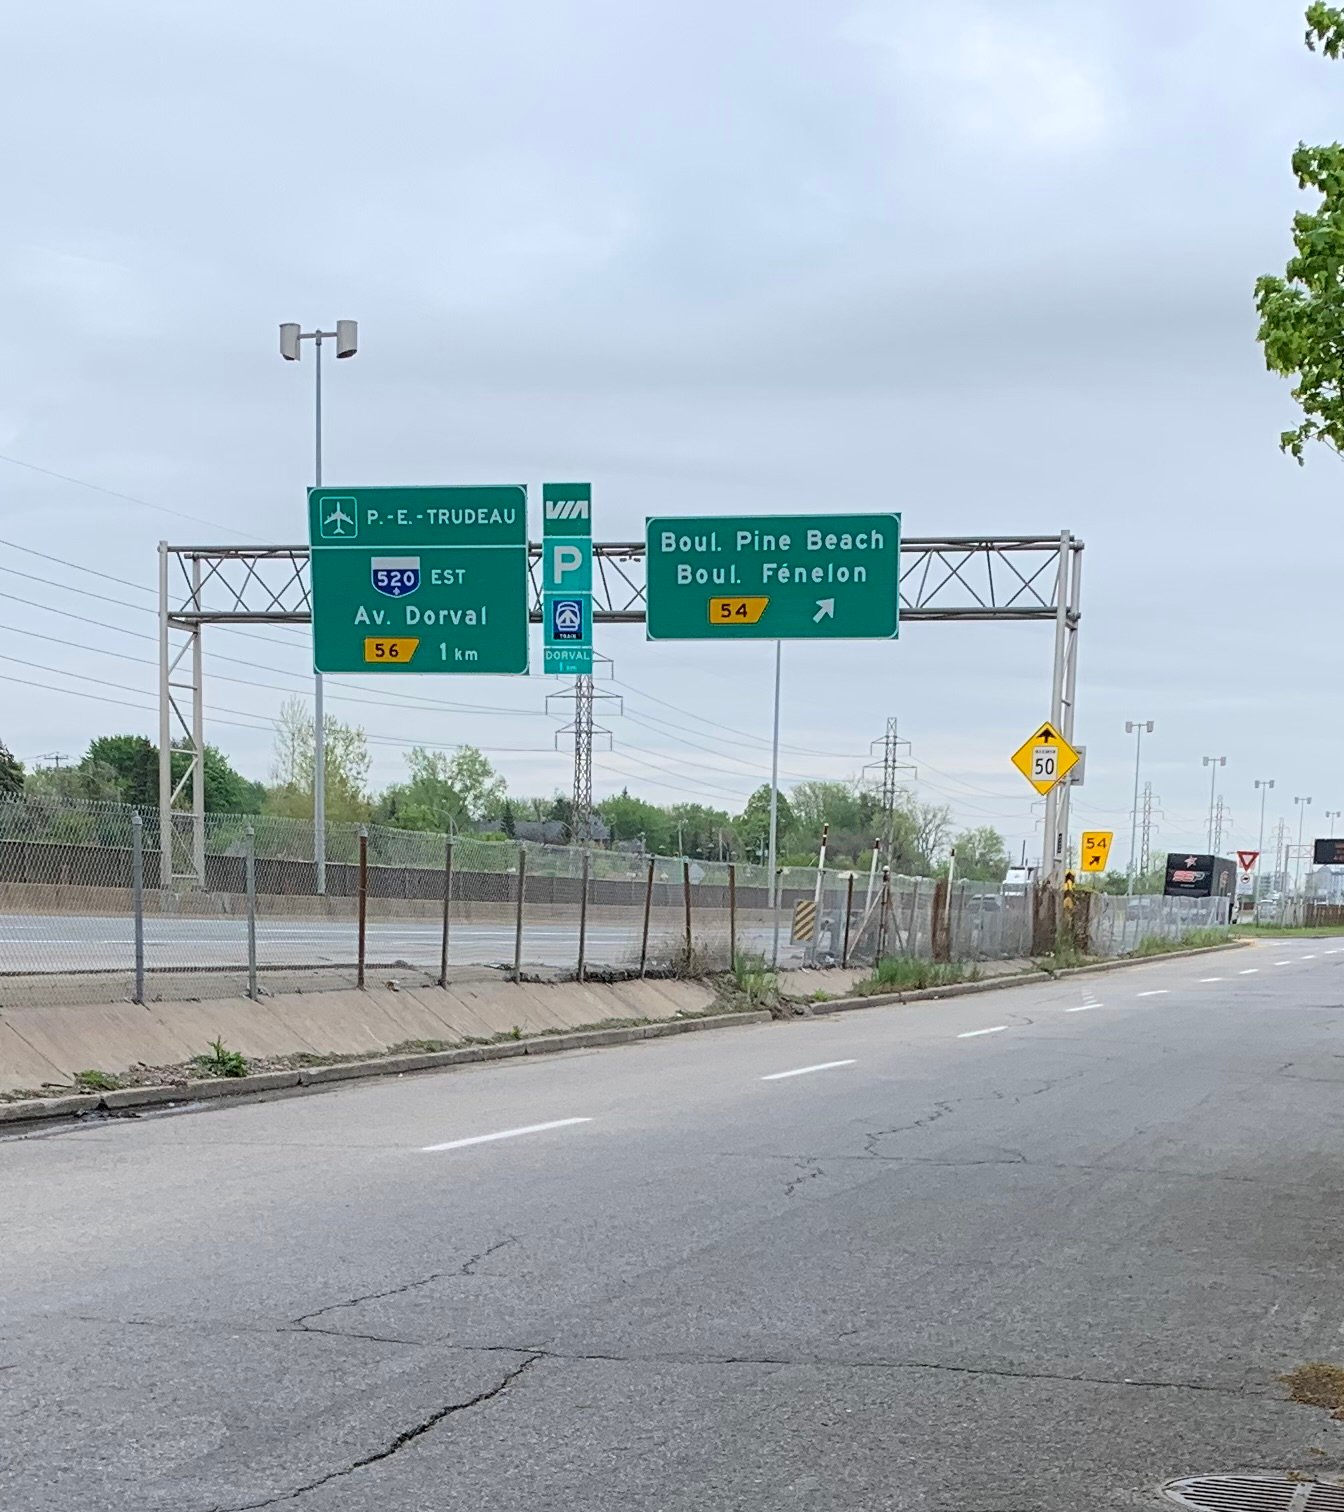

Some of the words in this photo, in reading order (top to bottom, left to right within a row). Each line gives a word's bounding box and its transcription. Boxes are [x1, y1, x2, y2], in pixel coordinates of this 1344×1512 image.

[546, 500, 588, 519] VIA
[661, 531, 722, 552] Boul.
[736, 530, 791, 551] Pine
[807, 529, 884, 551] Beach
[553, 546, 583, 584] P
[677, 564, 741, 585] Boul.
[762, 562, 867, 584] Fénelon
[377, 571, 415, 587] 520
[431, 569, 466, 585] EST
[354, 605, 391, 625] Av.
[406, 605, 487, 625] Dorval
[720, 603, 748, 618] 54
[375, 643, 399, 658] 56
[439, 642, 447, 661] 1
[455, 646, 478, 661] km
[546, 650, 590, 660] DORVAL
[1035, 758, 1054, 775] 50
[1086, 837, 1107, 849] 54
